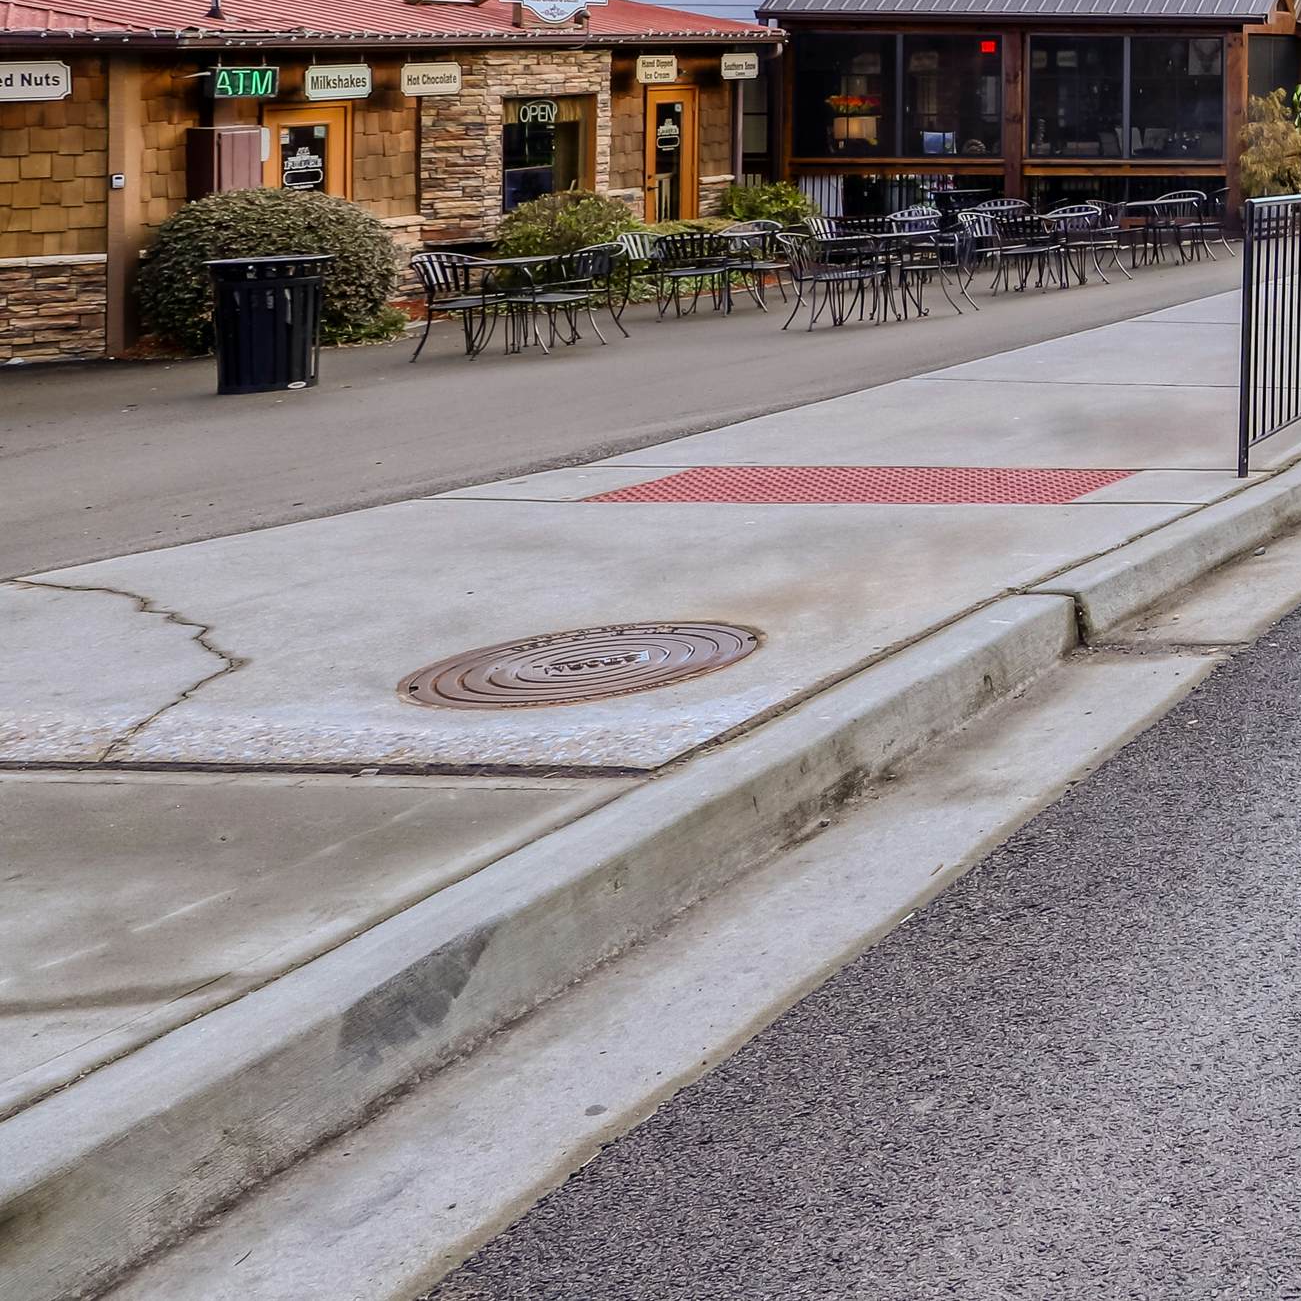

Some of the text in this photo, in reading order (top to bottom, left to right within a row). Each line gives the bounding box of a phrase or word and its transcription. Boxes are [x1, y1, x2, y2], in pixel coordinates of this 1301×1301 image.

[641, 59, 673, 69] Hand Dipped
[723, 62, 744, 71] Southern
[20, 72, 61, 87] Nuts
[310, 74, 367, 90] Milkshakes
[406, 73, 457, 86] Hot Chocolate
[644, 71, 670, 80] Ice Cream
[217, 70, 273, 96] ATM
[520, 104, 556, 123] OPEN
